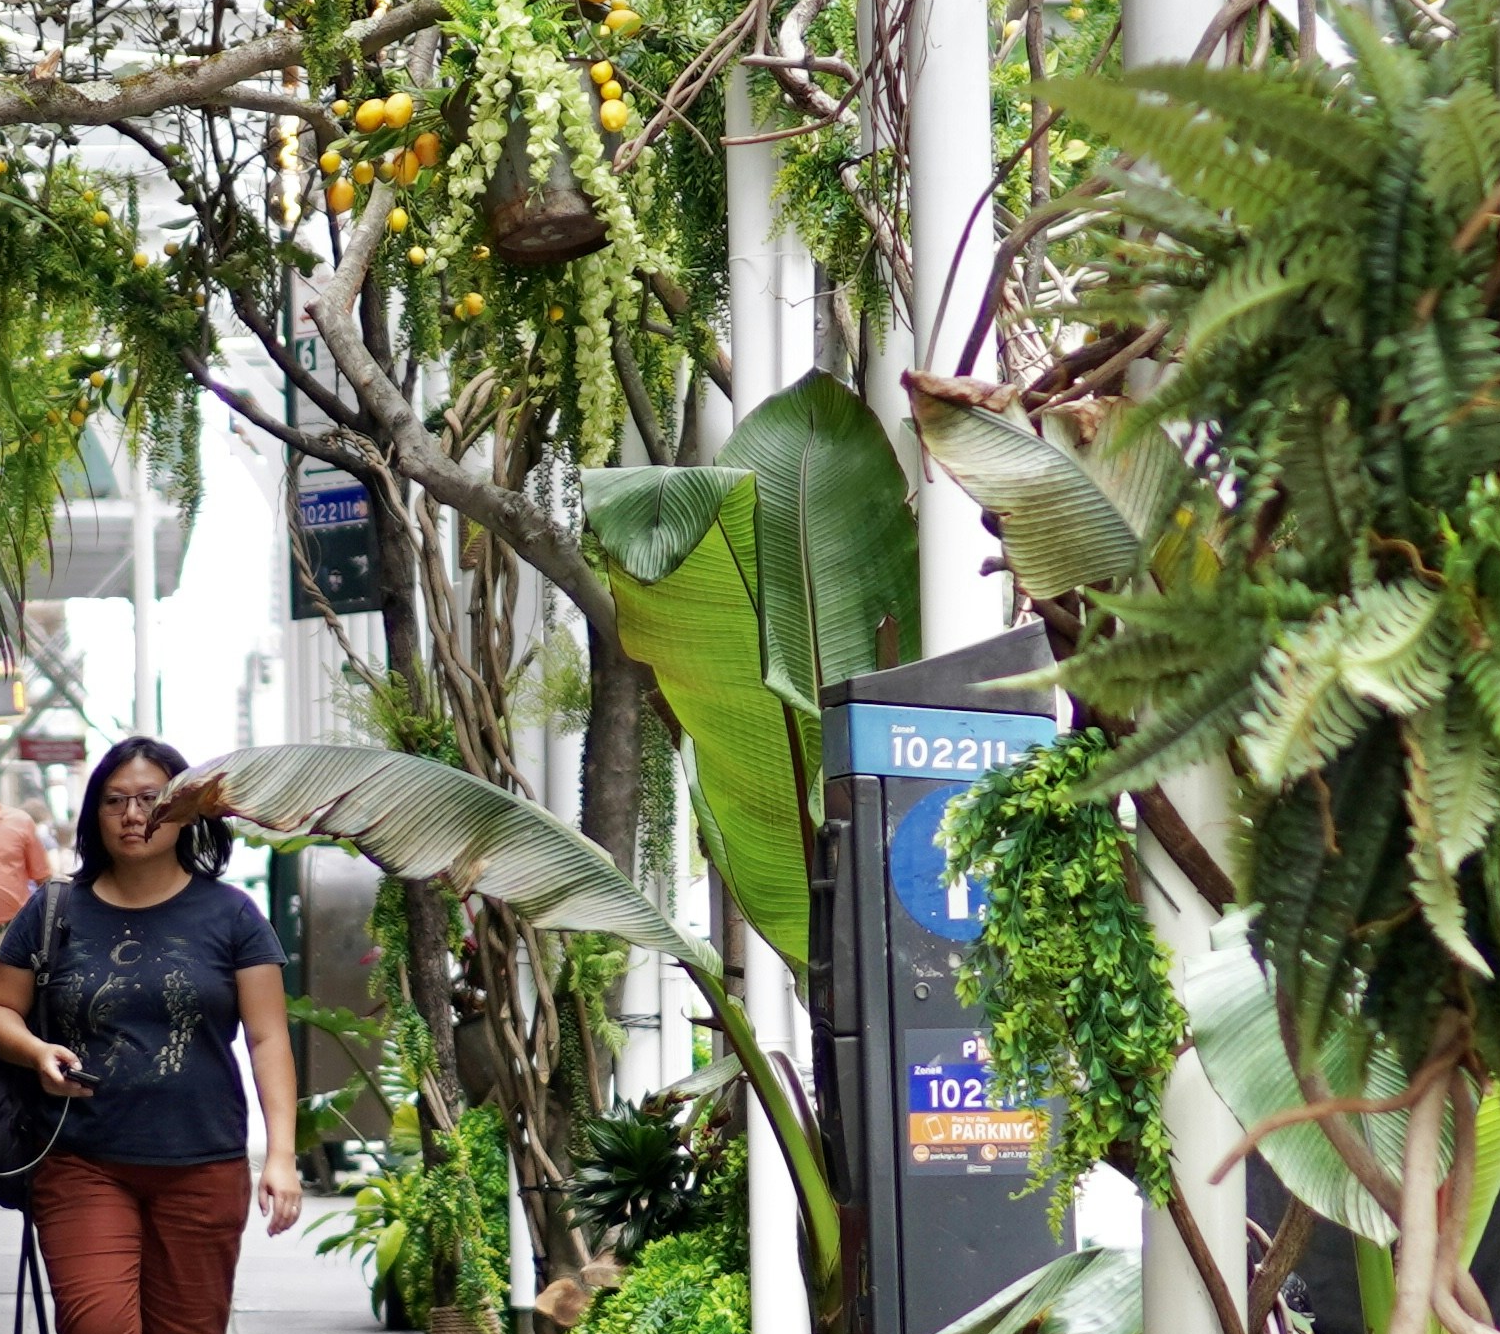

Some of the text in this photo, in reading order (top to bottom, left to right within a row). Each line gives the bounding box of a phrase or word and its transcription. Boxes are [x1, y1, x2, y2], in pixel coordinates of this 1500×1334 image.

[891, 724, 916, 733] Zone#
[893, 737, 1006, 770] 102211
[914, 1066, 942, 1076] Zone#
[951, 1122, 1035, 1140] PARKNYC
